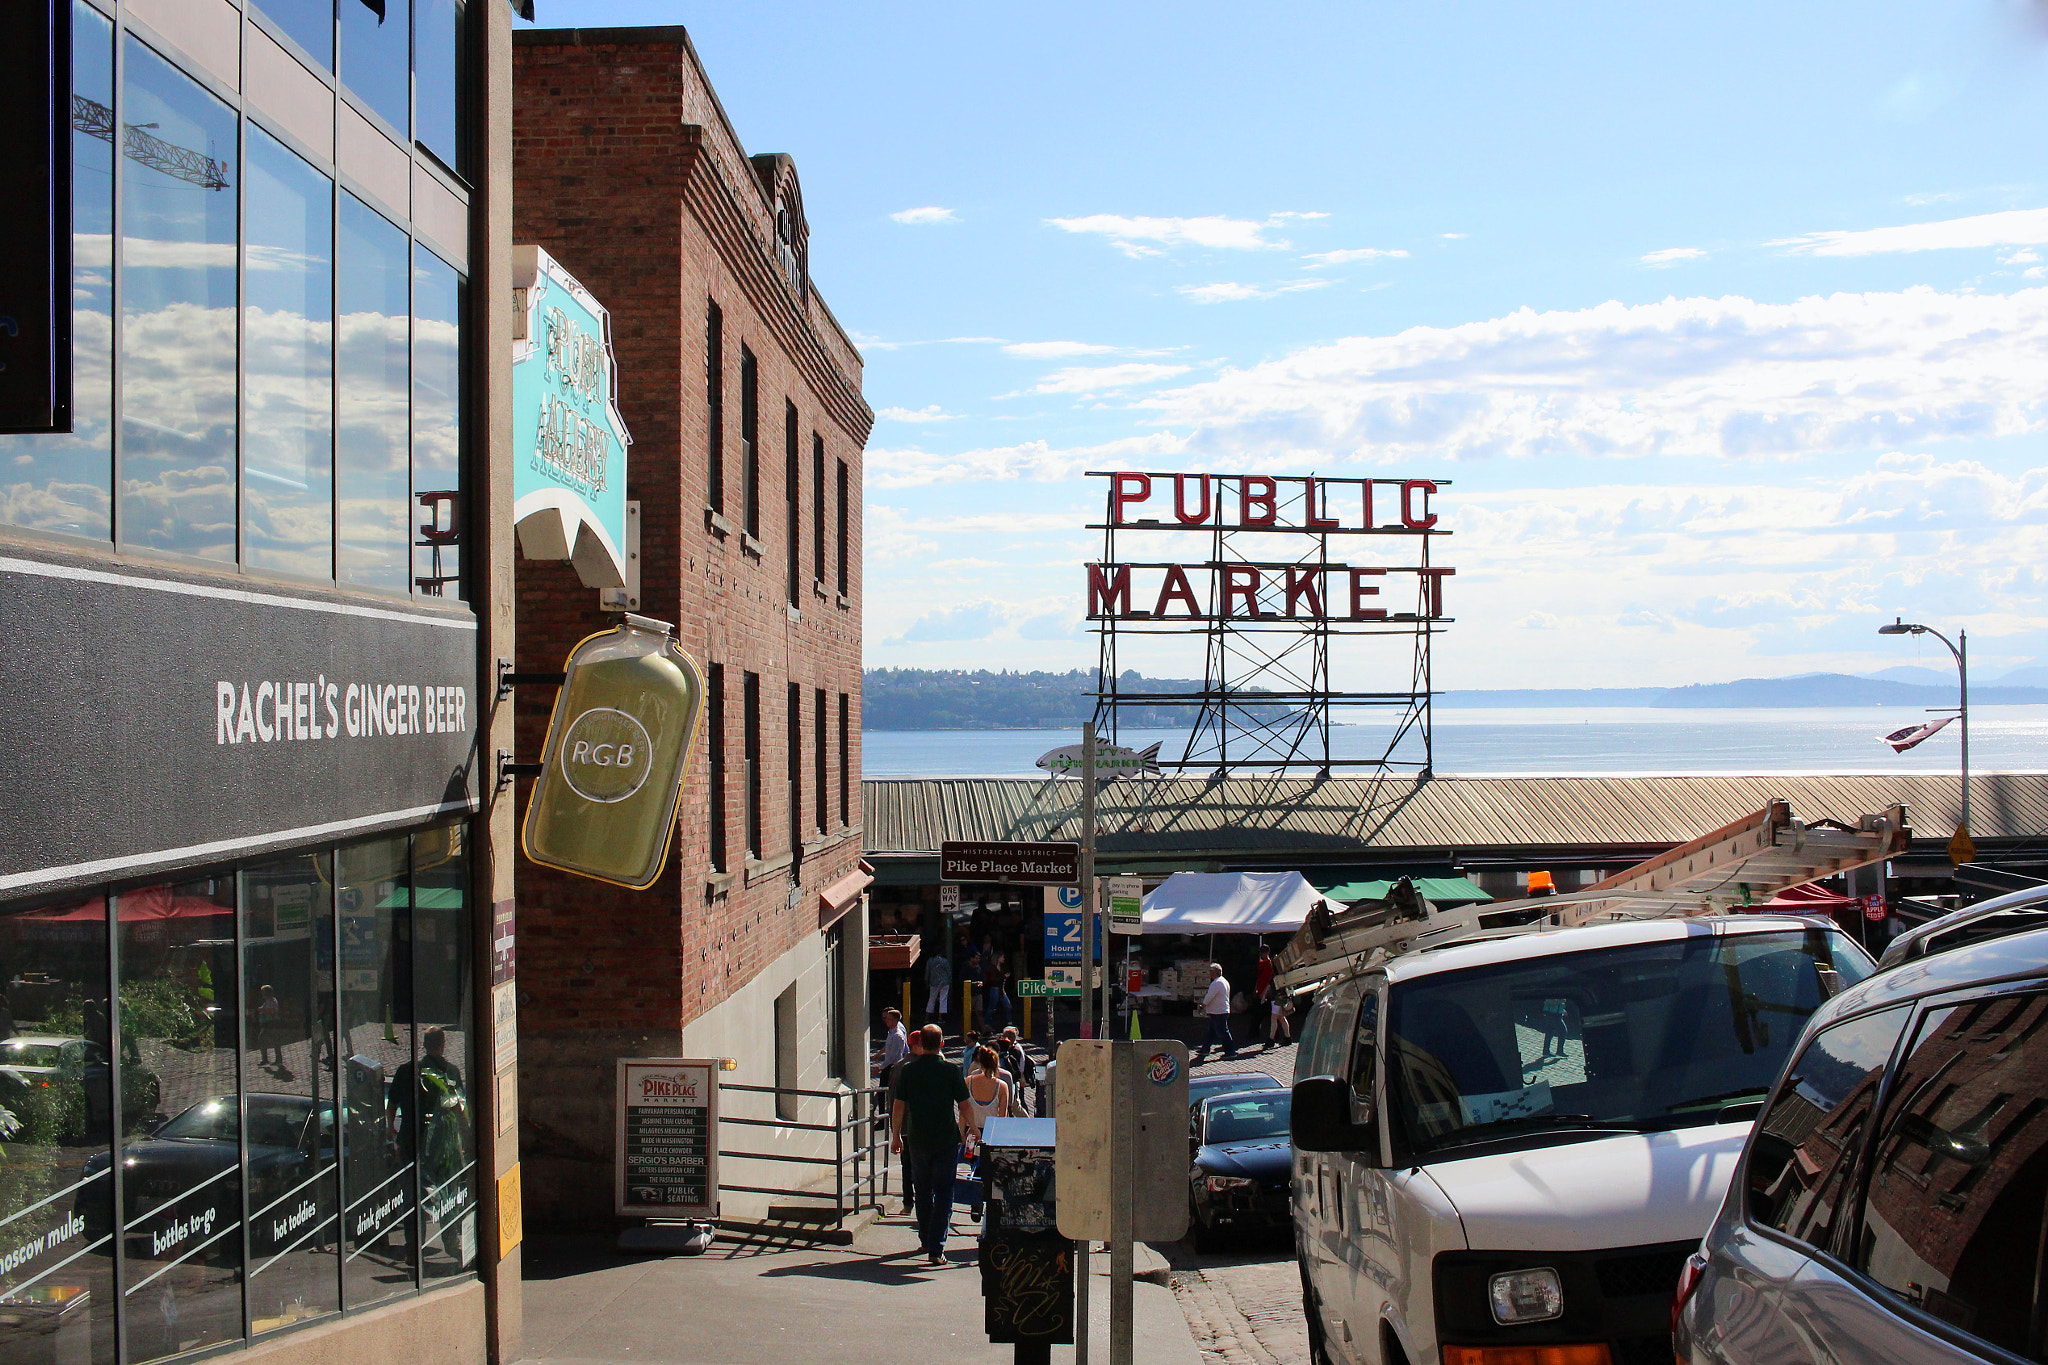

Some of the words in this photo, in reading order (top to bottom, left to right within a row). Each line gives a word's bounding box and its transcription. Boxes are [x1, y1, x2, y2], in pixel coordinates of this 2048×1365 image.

[1112, 472, 1437, 528] PUBLIC
[1087, 562, 1456, 618] MARKET
[217, 673, 339, 744] RACHEL'S
[345, 683, 420, 737] GINGER
[425, 685, 466, 734] BEER
[572, 740, 634, 768] RGB
[1051, 760, 1083, 768] FISH
[963, 848, 1013, 856] HISTORICAL
[946, 860, 978, 872] Pike
[980, 860, 1018, 873] Place
[1021, 861, 1073, 874] Market
[942, 894, 958, 902] WAY
[1066, 888, 1080, 902] P
[1063, 919, 1081, 942] 2
[1022, 982, 1047, 994] Pike
[644, 1080, 670, 1095] PIKE
[672, 1083, 696, 1096] PLACE
[628, 1156, 667, 1164] SERGIO'S
[669, 1156, 704, 1165] BARBER
[667, 1187, 695, 1195] PUBLIC
[667, 1195, 699, 1203] SEATING
[432, 1206, 440, 1225] for
[440, 1196, 456, 1217] better
[456, 1186, 468, 1206] days
[273, 1220, 288, 1242] hot
[288, 1200, 316, 1229] toddies
[356, 1207, 374, 1236] drink
[375, 1198, 391, 1230] great
[999, 1216, 1015, 1225] The
[47, 1210, 85, 1249] mules
[153, 1219, 188, 1256] bottles
[190, 1207, 216, 1235] to-go
